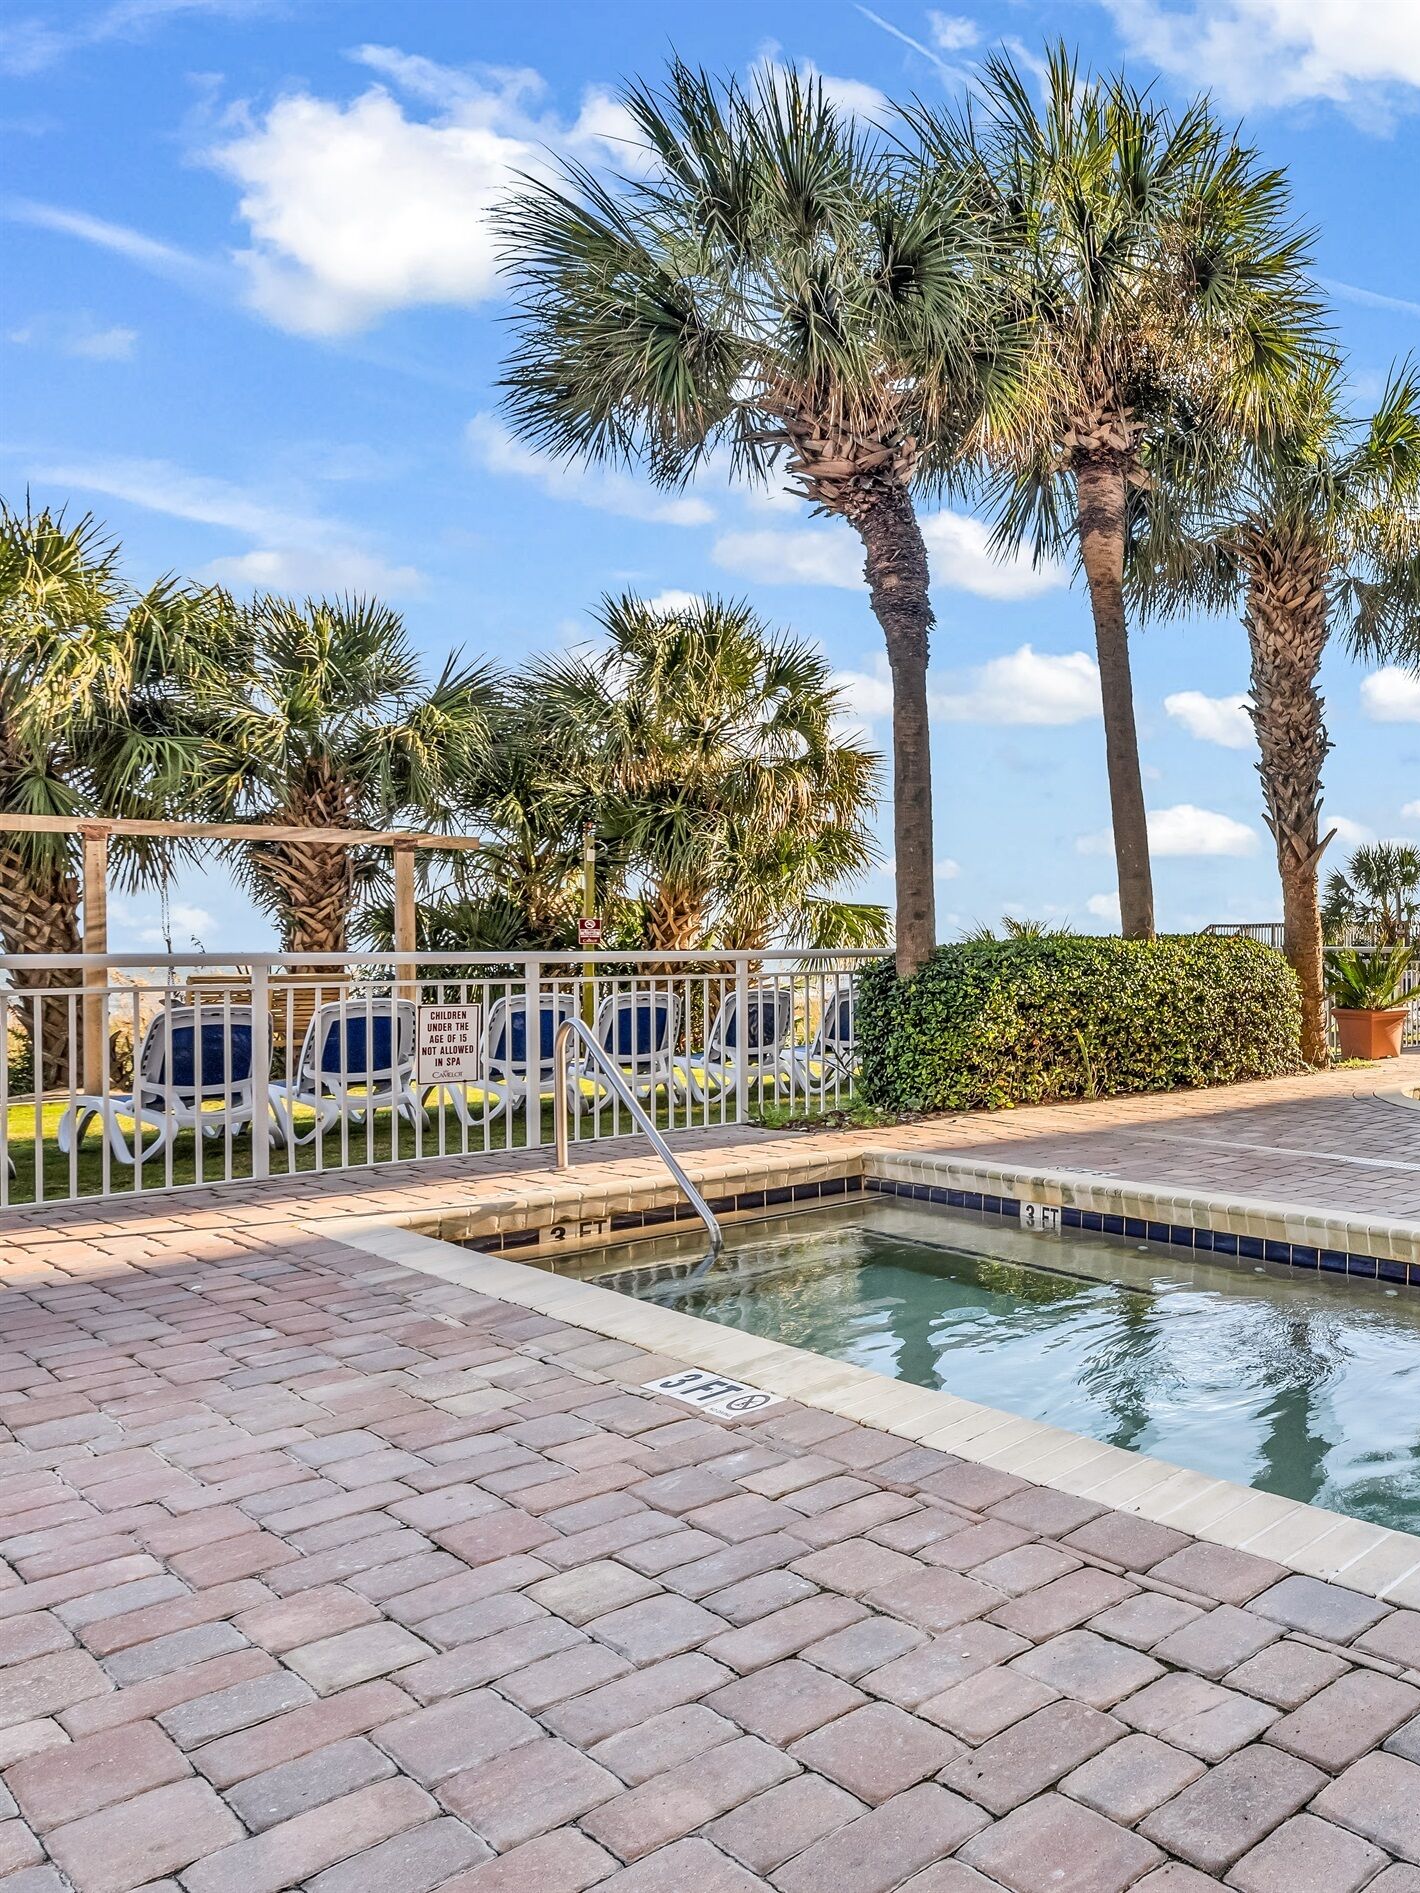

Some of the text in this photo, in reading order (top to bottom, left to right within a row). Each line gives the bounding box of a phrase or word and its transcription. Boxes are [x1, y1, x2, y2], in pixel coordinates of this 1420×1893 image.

[430, 1010, 467, 1020] CHILDREN
[427, 1021, 470, 1032] UNDER THE
[429, 1033, 468, 1044] AGE OF 15
[421, 1045, 474, 1056] NOT ALLOWED
[434, 1057, 461, 1067] IN SPA
[1025, 1204, 1059, 1221] 3 FT
[550, 1219, 608, 1241] 3 FT
[659, 1373, 744, 1401] 3 FT
